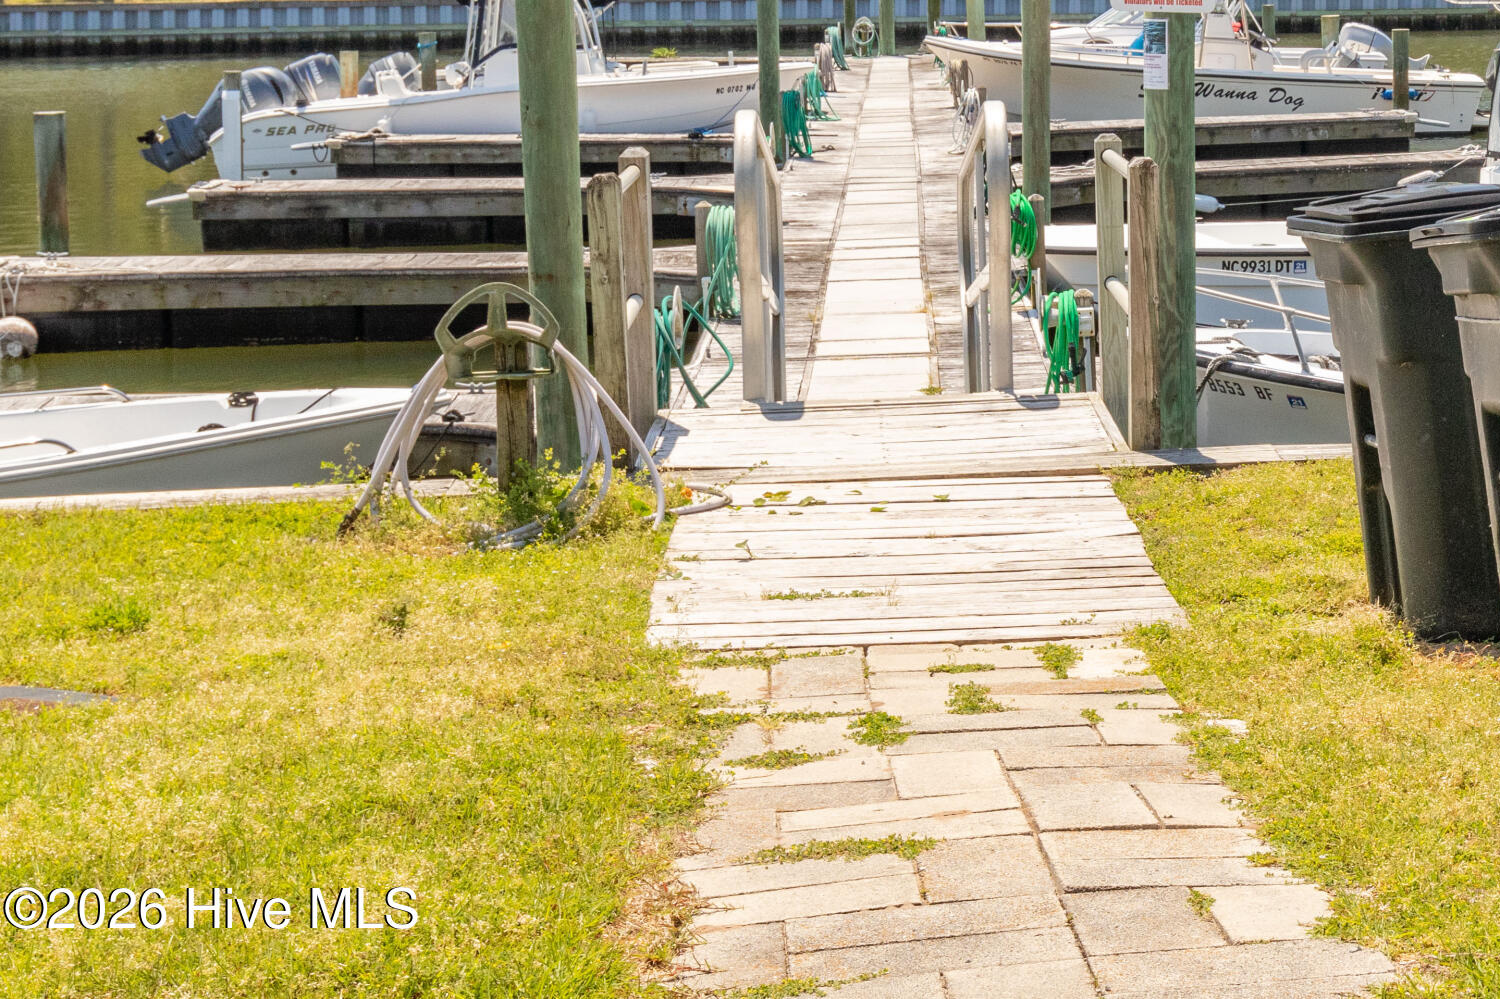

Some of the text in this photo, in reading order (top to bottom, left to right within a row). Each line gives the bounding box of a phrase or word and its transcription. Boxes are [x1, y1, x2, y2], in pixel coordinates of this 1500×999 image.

[1194, 81, 1305, 112] Wanna Dog
[265, 123, 337, 137] SEA PRO
[1275, 260, 1292, 273] DT
